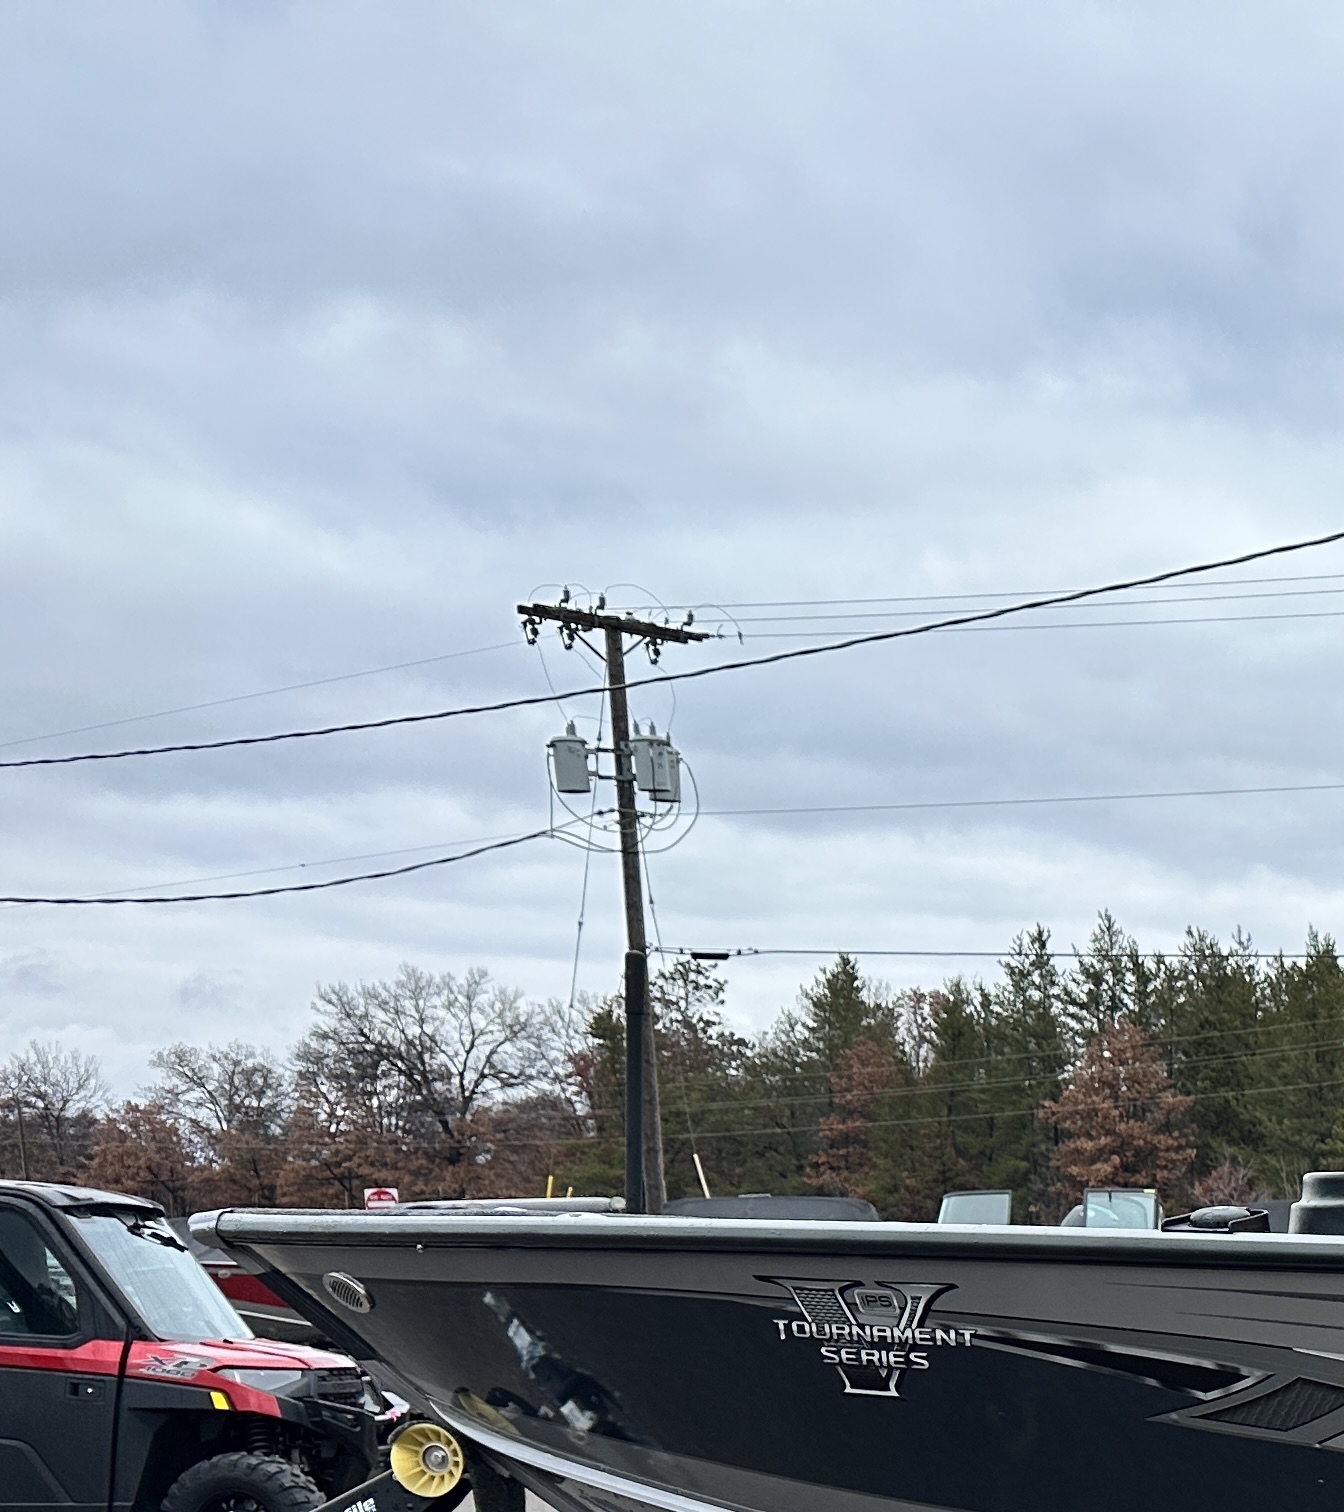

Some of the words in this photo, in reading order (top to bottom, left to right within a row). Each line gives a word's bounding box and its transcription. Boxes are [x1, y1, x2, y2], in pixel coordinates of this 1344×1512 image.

[860, 1294, 893, 1308] IPS
[772, 1318, 979, 1347] TOURNAMENT
[819, 1346, 930, 1370] SERIES
